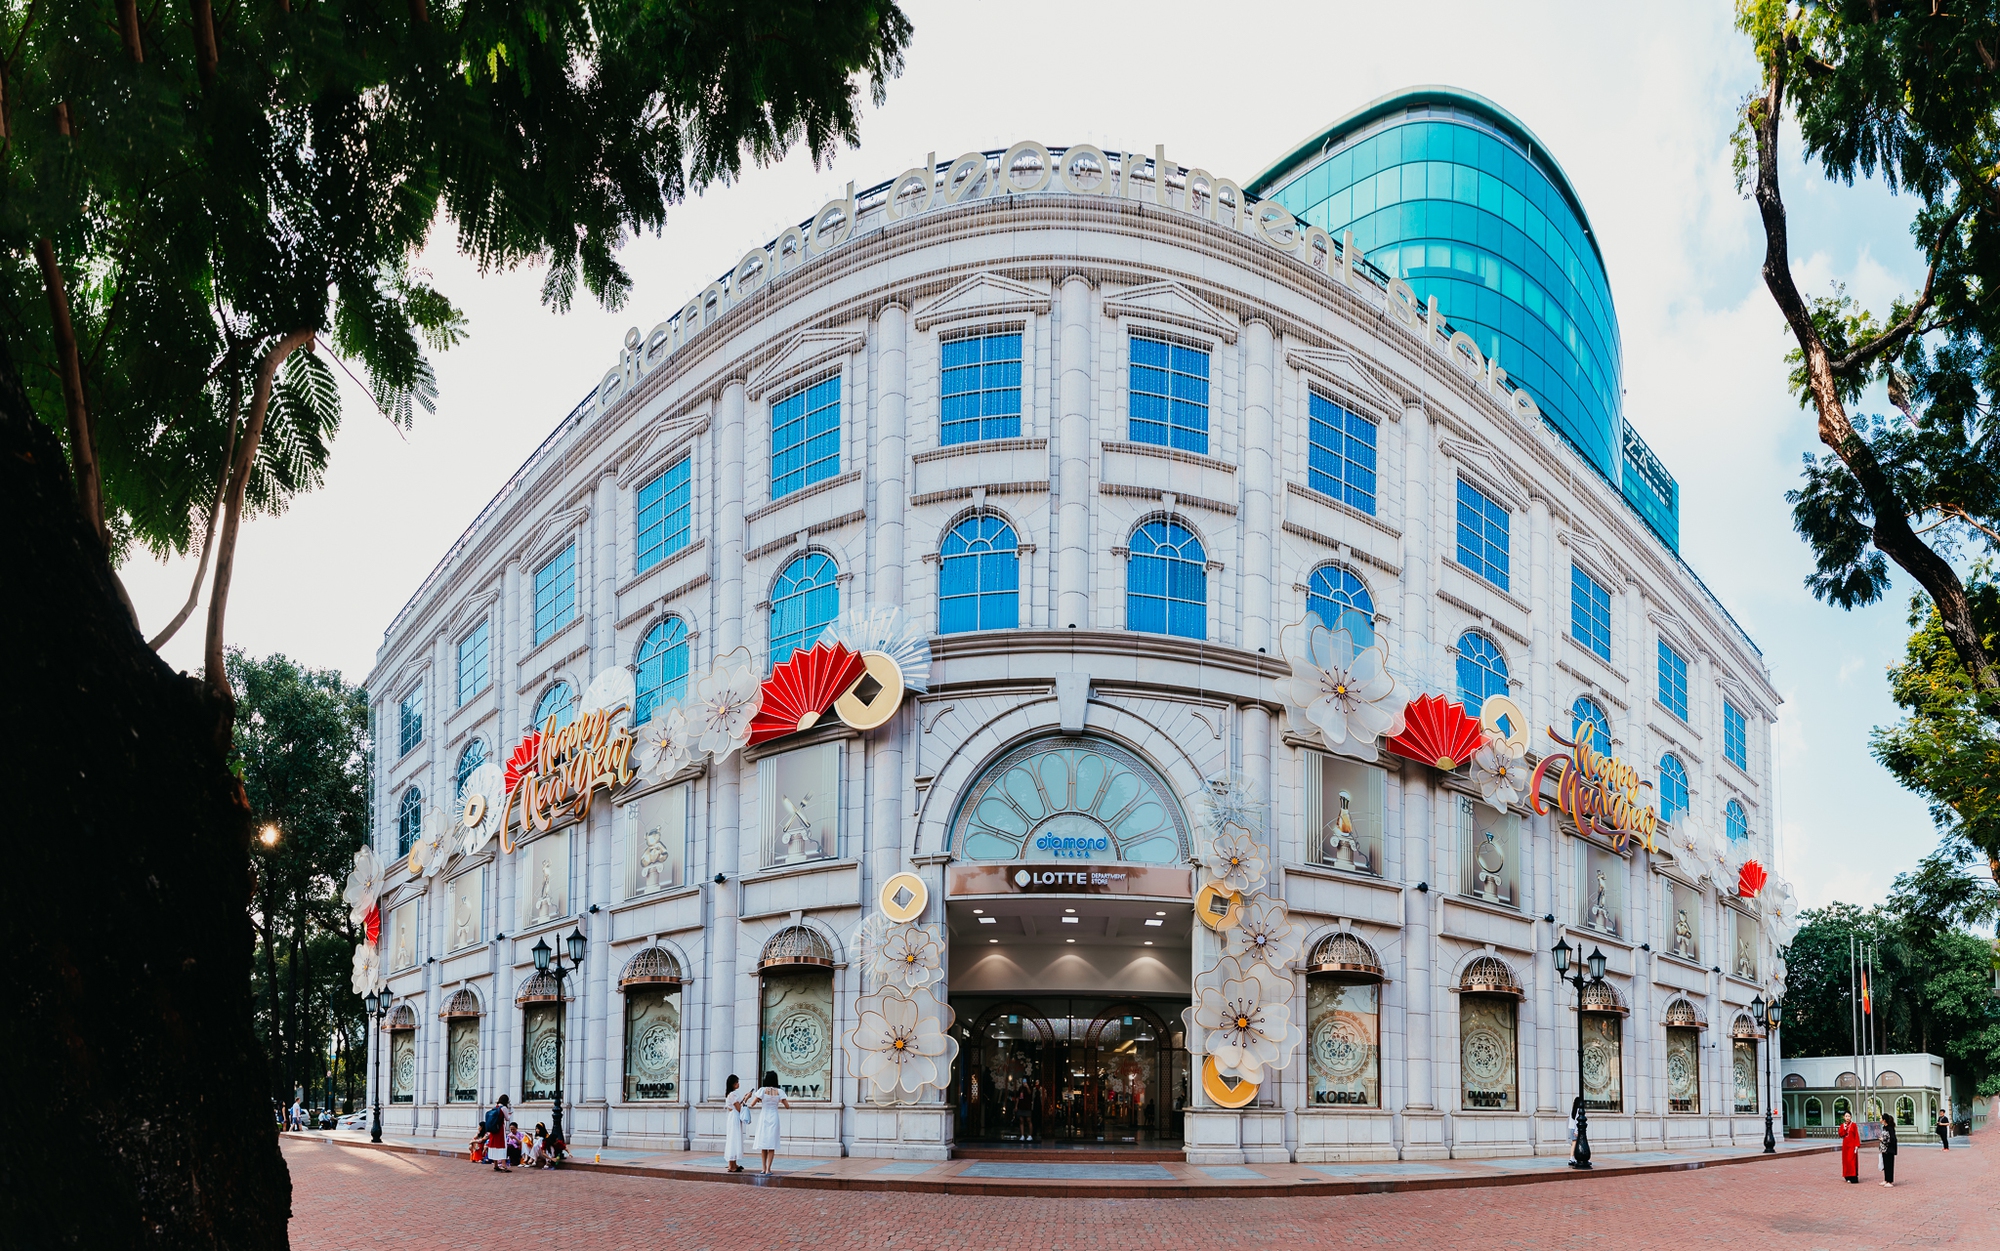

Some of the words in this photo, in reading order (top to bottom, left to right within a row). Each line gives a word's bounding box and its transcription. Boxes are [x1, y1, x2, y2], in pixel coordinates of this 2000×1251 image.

[596, 181, 855, 413] diamond
[886, 140, 1365, 292] department
[1386, 277, 1544, 435] store
[1036, 832, 1107, 851] diamond
[1054, 850, 1090, 859] PLAZA
[1033, 872, 1087, 885] LOTTE
[1091, 872, 1126, 882] DEPARTMENT
[636, 1083, 675, 1091] DIAMOND
[1316, 1091, 1368, 1104] KOREA
[1468, 1090, 1507, 1100] DIAMOND
